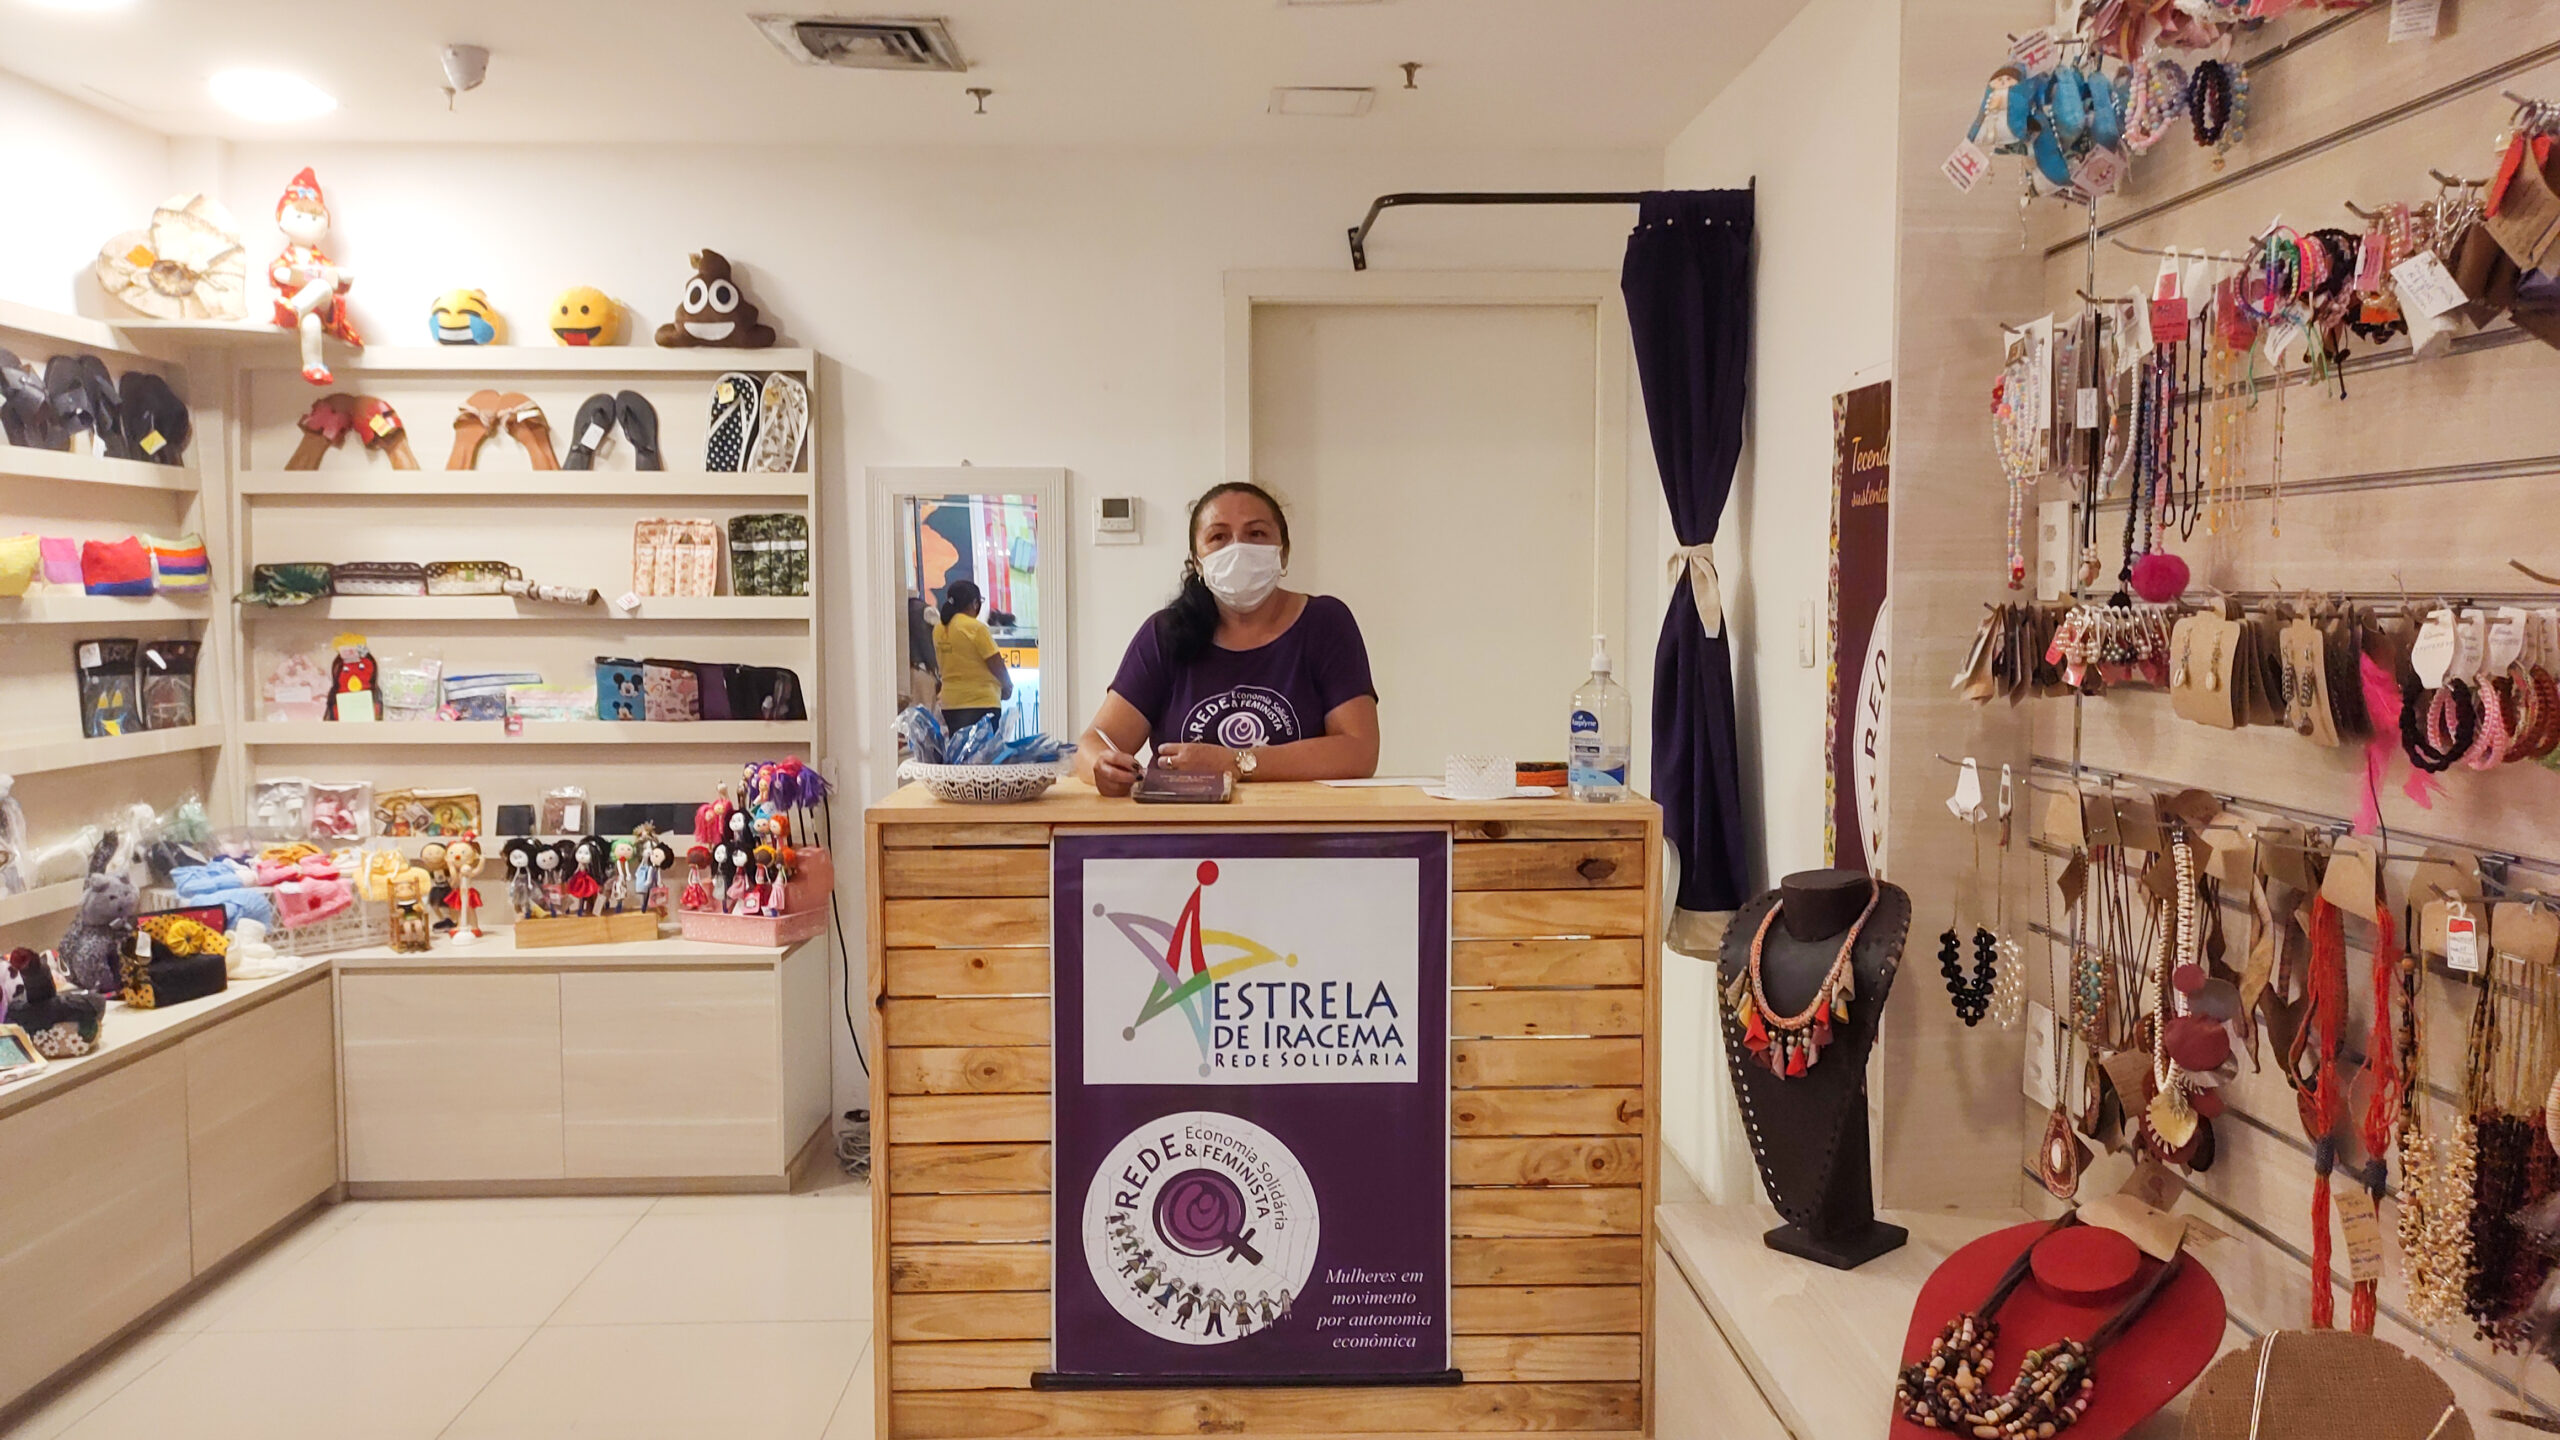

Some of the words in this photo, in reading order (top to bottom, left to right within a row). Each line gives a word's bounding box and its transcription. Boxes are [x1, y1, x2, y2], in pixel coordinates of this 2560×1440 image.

[1231, 690, 1272, 704] Economia
[1189, 696, 1231, 734] REDE
[1240, 699, 1283, 732] FEMINISTA
[1213, 980, 1398, 1020] ESTRELA
[1214, 1024, 1249, 1049] DE
[1264, 1021, 1404, 1049] IRACEMA
[1215, 1053, 1270, 1068] REDE
[1281, 1049, 1407, 1067] SOLIDÁRIA
[1114, 1133, 1182, 1210] REDE
[1184, 1143, 1198, 1158] &
[1202, 1144, 1271, 1220] FEMINISTA
[1185, 1126, 1259, 1164] Economia
[1256, 1161, 1285, 1231] Solidária
[1325, 1268, 1396, 1284] Mulheres
[1401, 1271, 1424, 1283] em
[1331, 1291, 1417, 1305] movimento
[1316, 1314, 1345, 1331] por
[1349, 1312, 1432, 1327] autonomia
[1332, 1334, 1417, 1350] econômica
